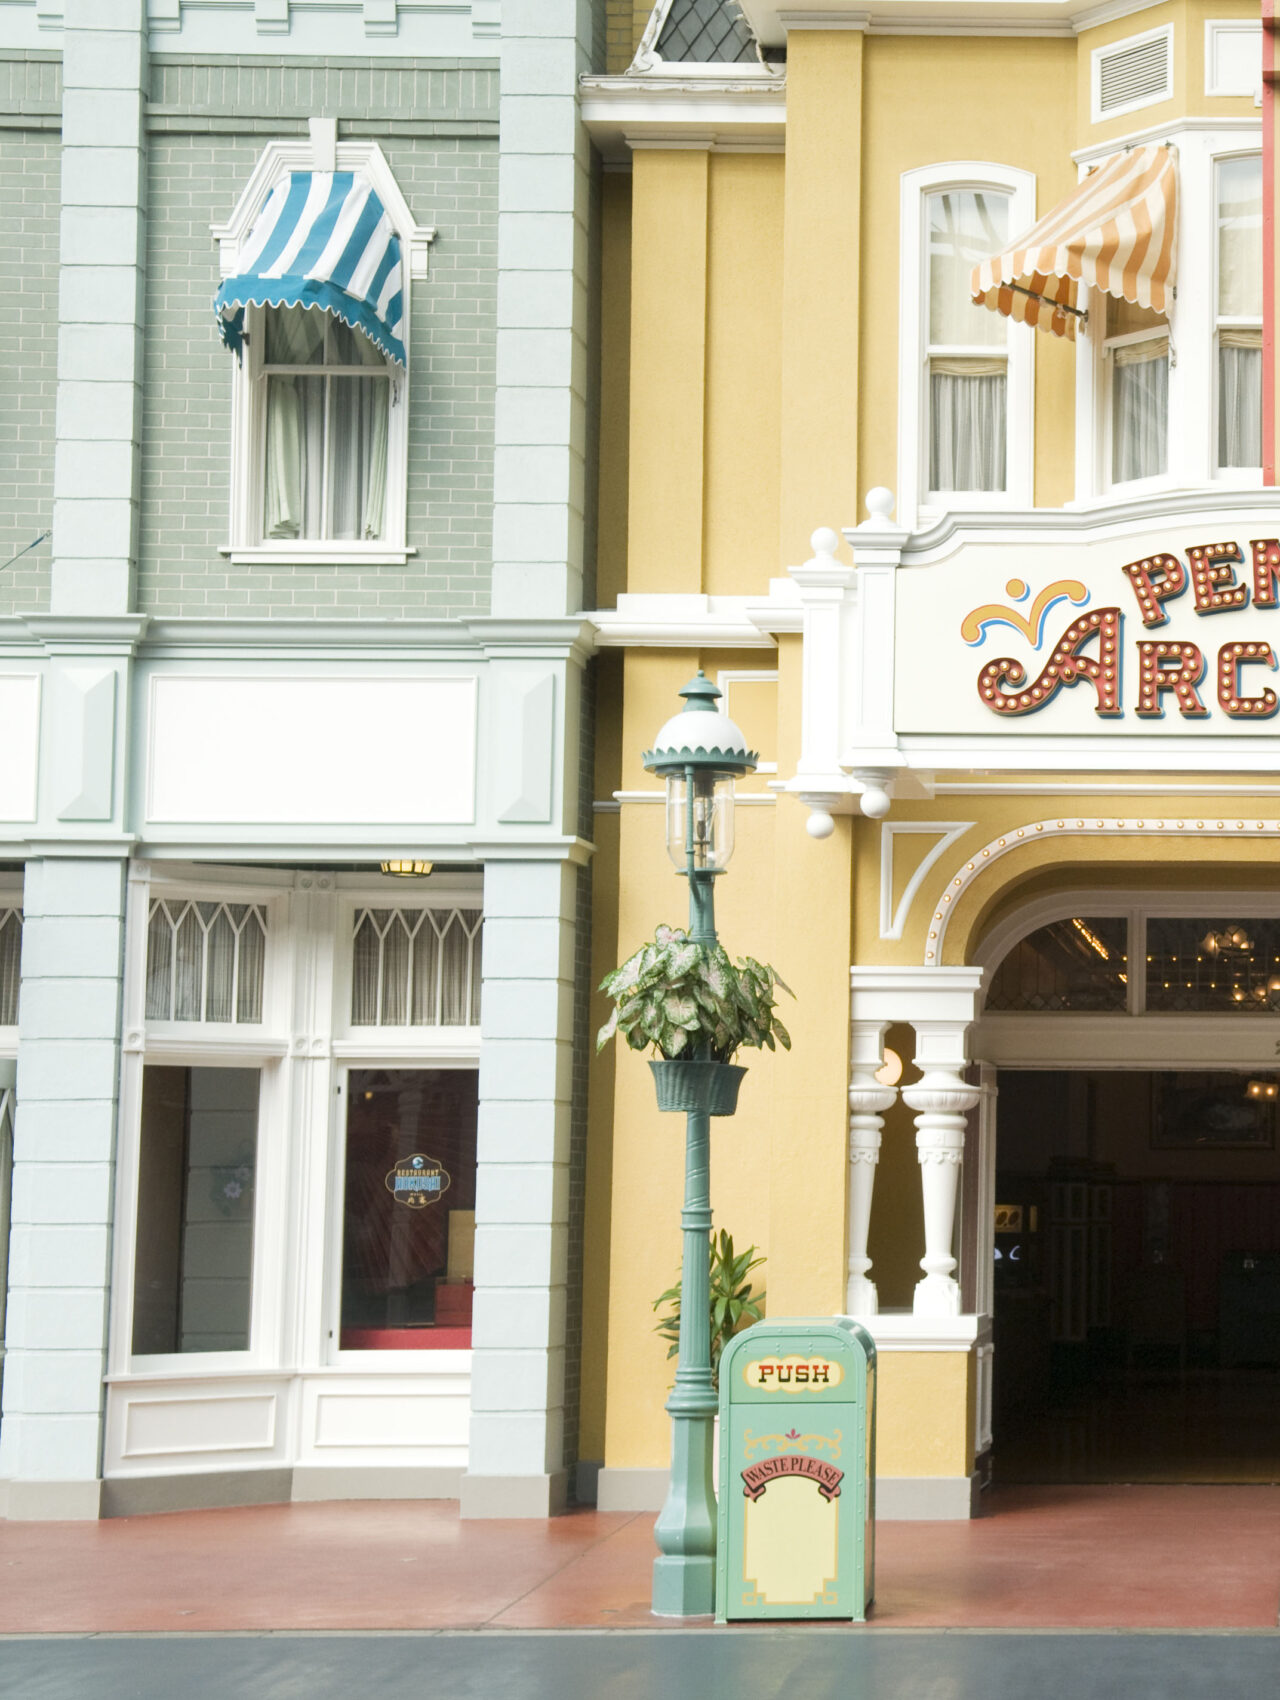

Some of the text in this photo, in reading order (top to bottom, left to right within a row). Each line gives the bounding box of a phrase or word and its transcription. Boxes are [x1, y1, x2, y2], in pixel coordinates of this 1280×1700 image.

[758, 1365, 830, 1383] PUSH
[746, 1457, 840, 1486] WASTE PLEASE
